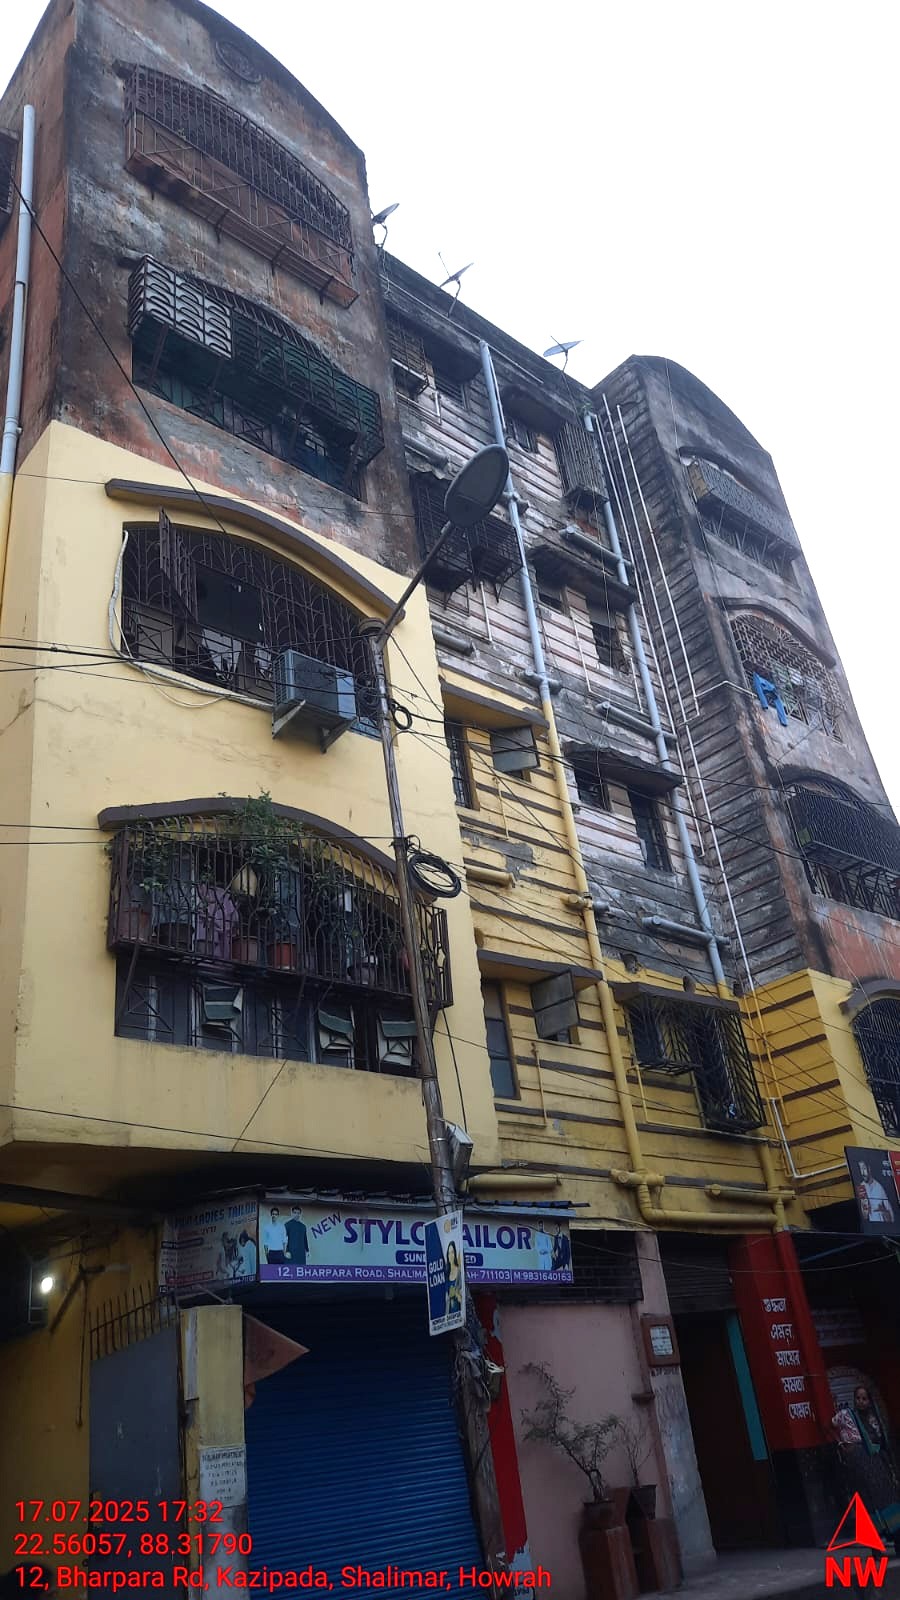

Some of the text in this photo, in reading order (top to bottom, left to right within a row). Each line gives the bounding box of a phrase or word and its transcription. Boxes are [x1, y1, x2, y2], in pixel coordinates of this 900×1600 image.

[311, 1211, 342, 1239] NEW
[463, 1223, 532, 1250] AILOR
[277, 1266, 294, 1278] 12,
[296, 1267, 352, 1278] BHARPARA
[387, 1268, 427, 1279] SHALIMA
[428, 1258, 444, 1274] GOLD
[429, 1271, 446, 1288] LOAN
